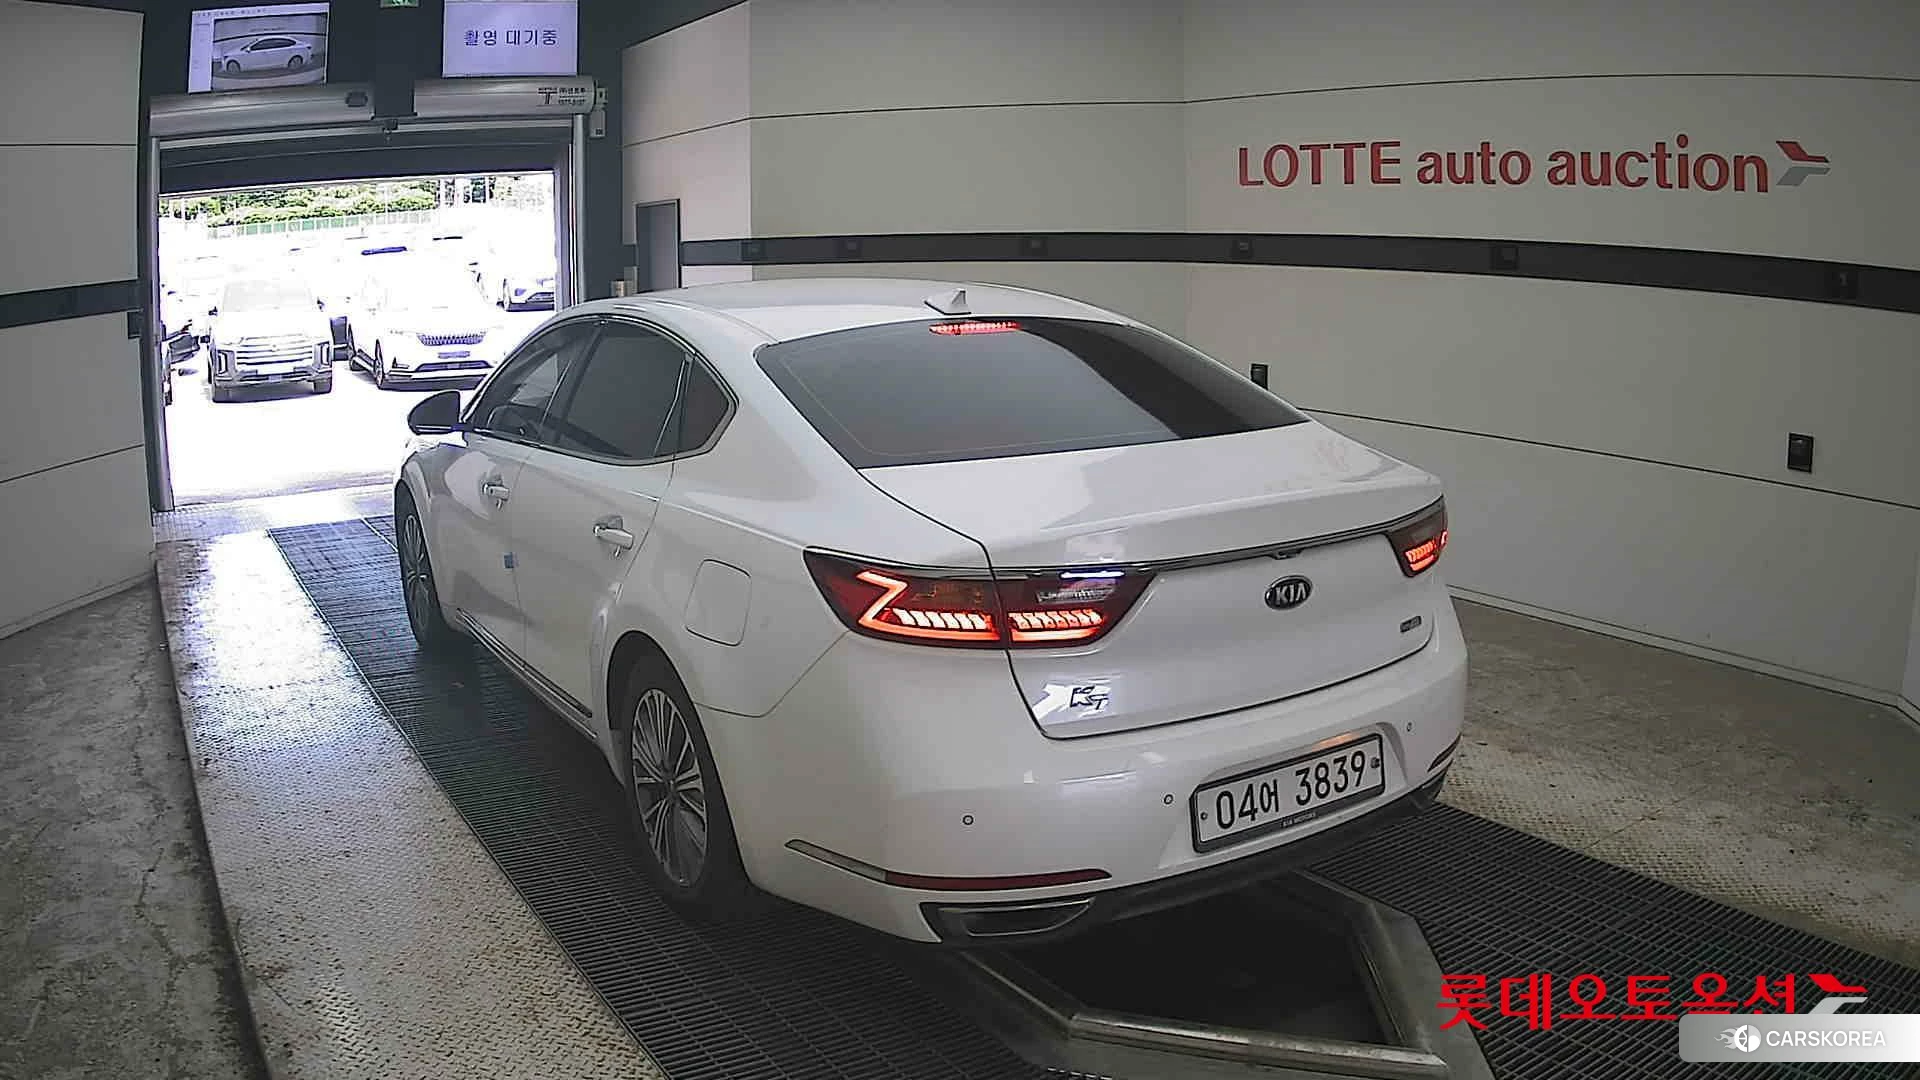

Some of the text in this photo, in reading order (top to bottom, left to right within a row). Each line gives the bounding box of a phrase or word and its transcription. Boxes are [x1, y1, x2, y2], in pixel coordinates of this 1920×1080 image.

[506, 29, 558, 46] 대기중
[1238, 134, 1768, 193] LOTTE auto auction
[1216, 750, 1366, 830] 04어 3839
